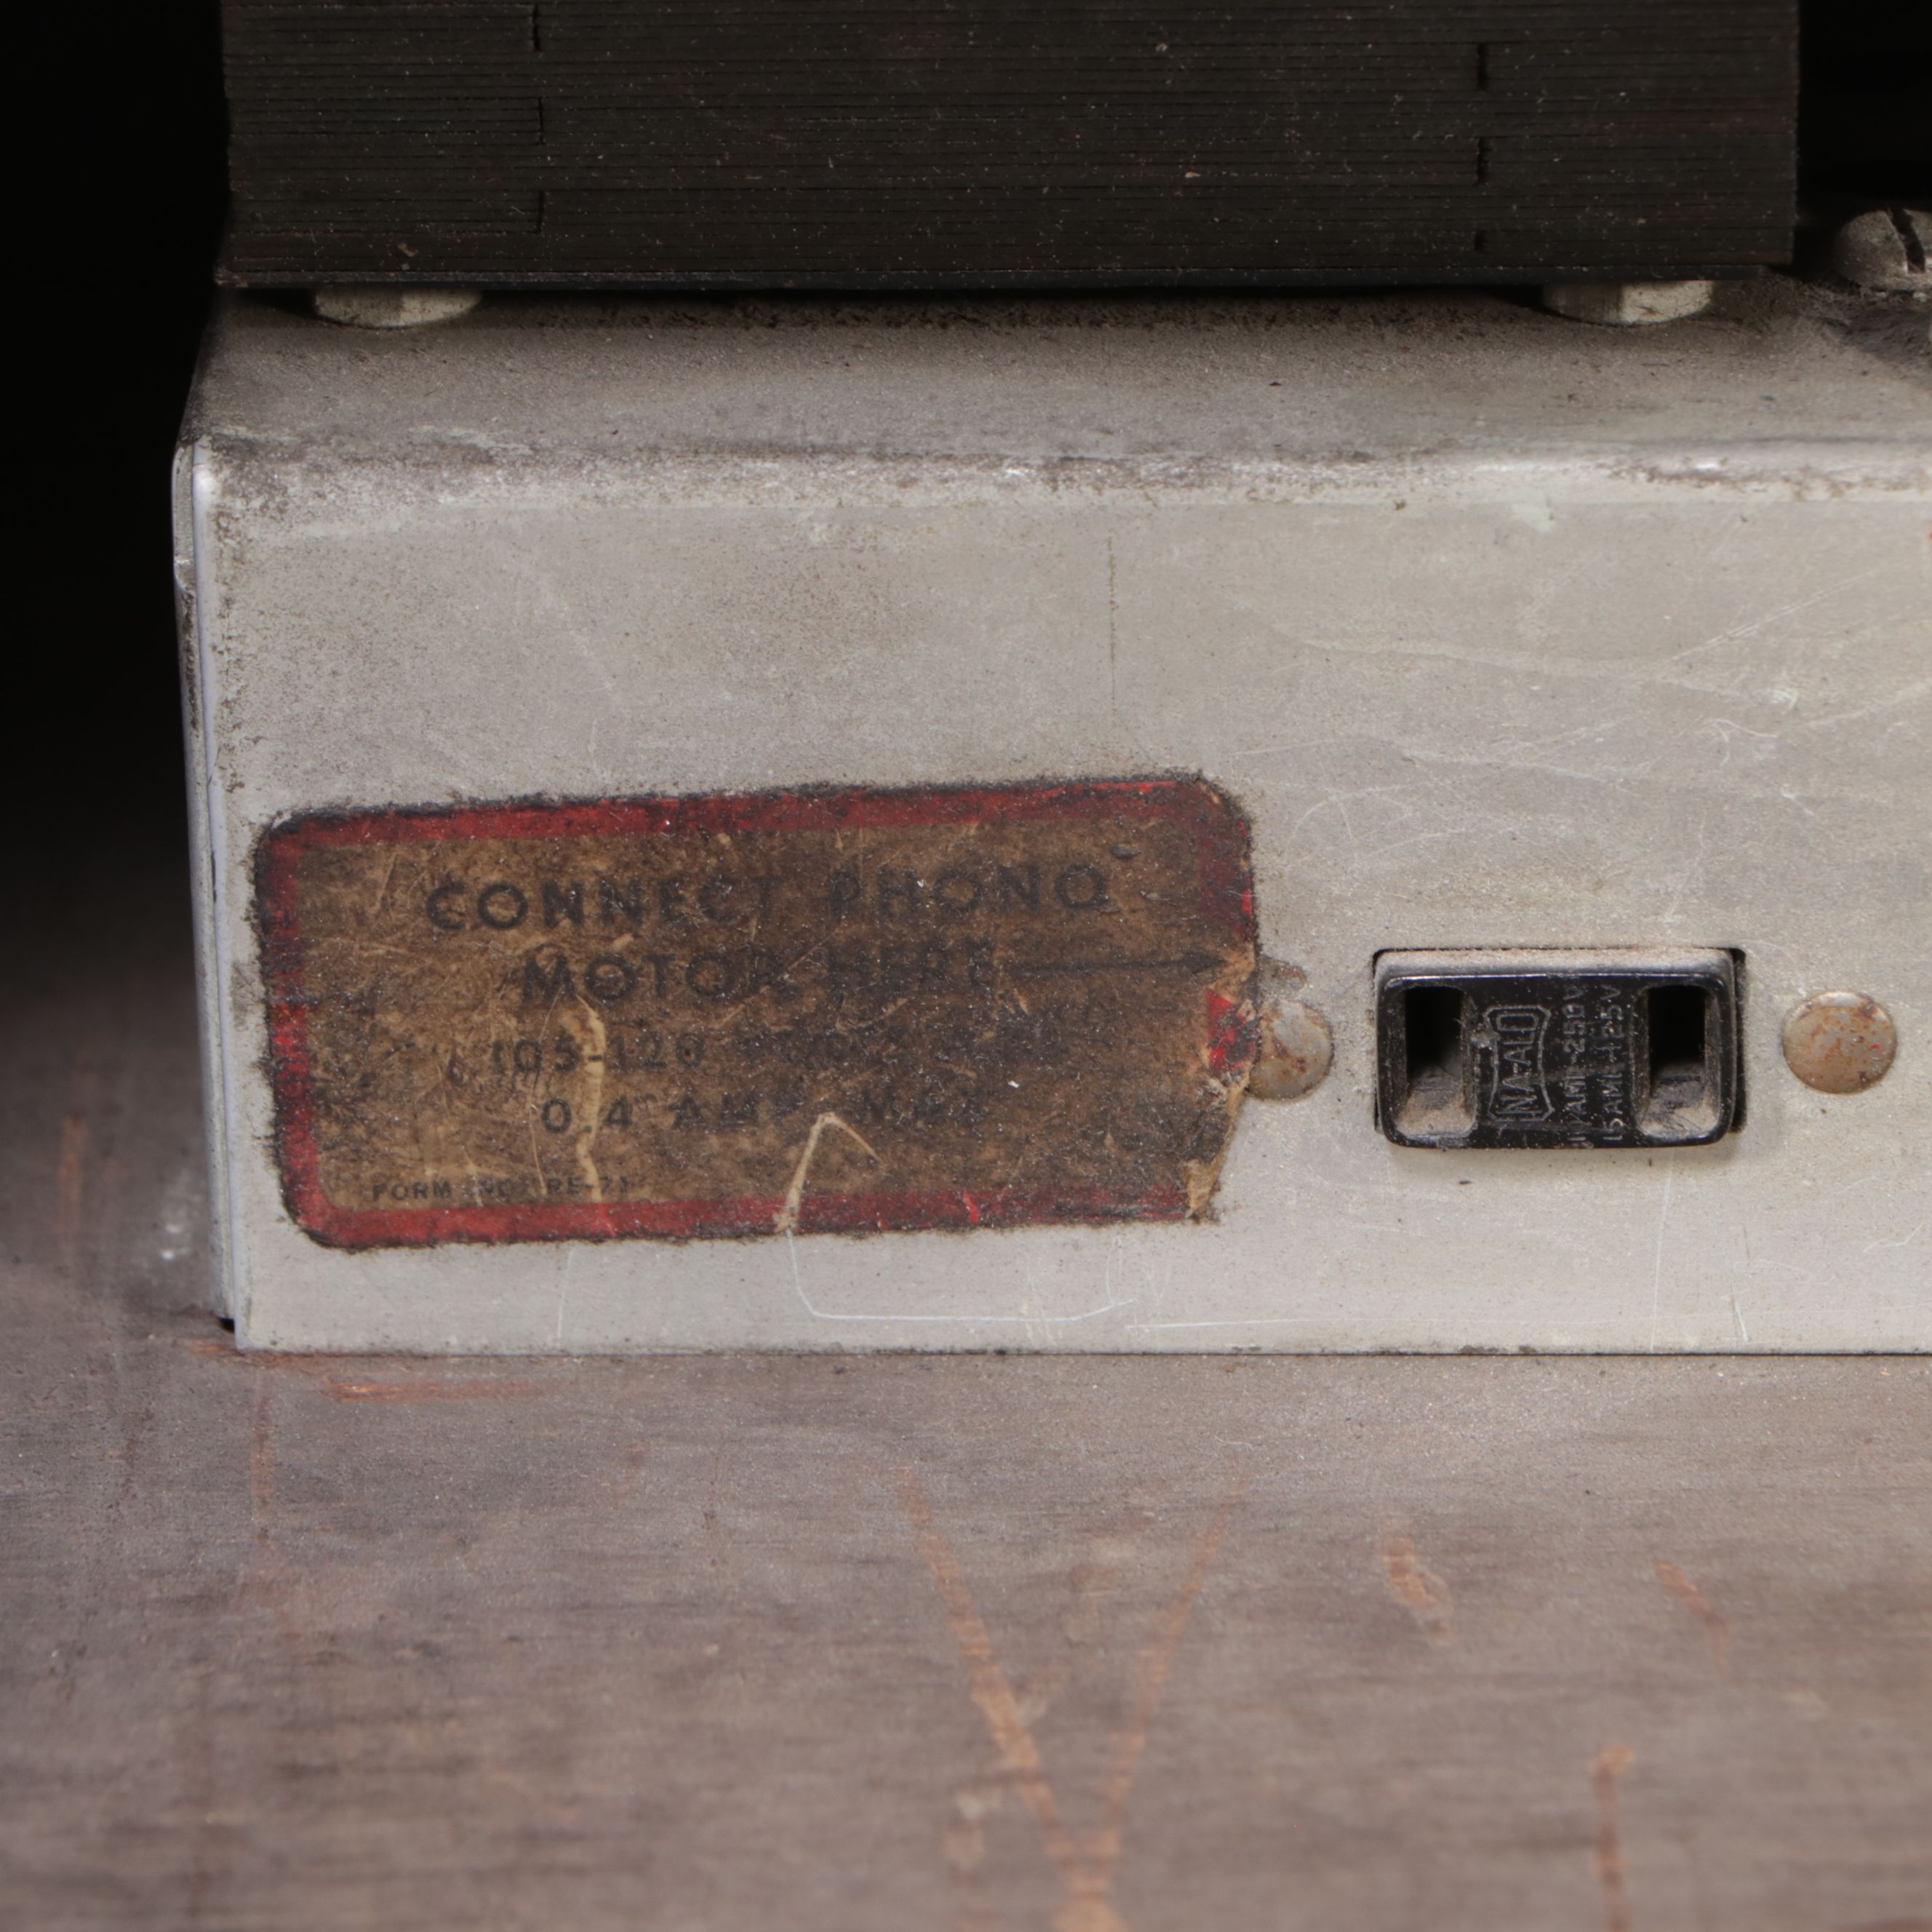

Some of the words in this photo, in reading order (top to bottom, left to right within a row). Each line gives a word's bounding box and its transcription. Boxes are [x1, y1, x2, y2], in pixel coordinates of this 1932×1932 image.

[425, 875, 780, 931] CONNECT
[828, 864, 1107, 919] PHONO
[522, 946, 786, 1002] MOTOR
[372, 1179, 452, 1200] FORM
